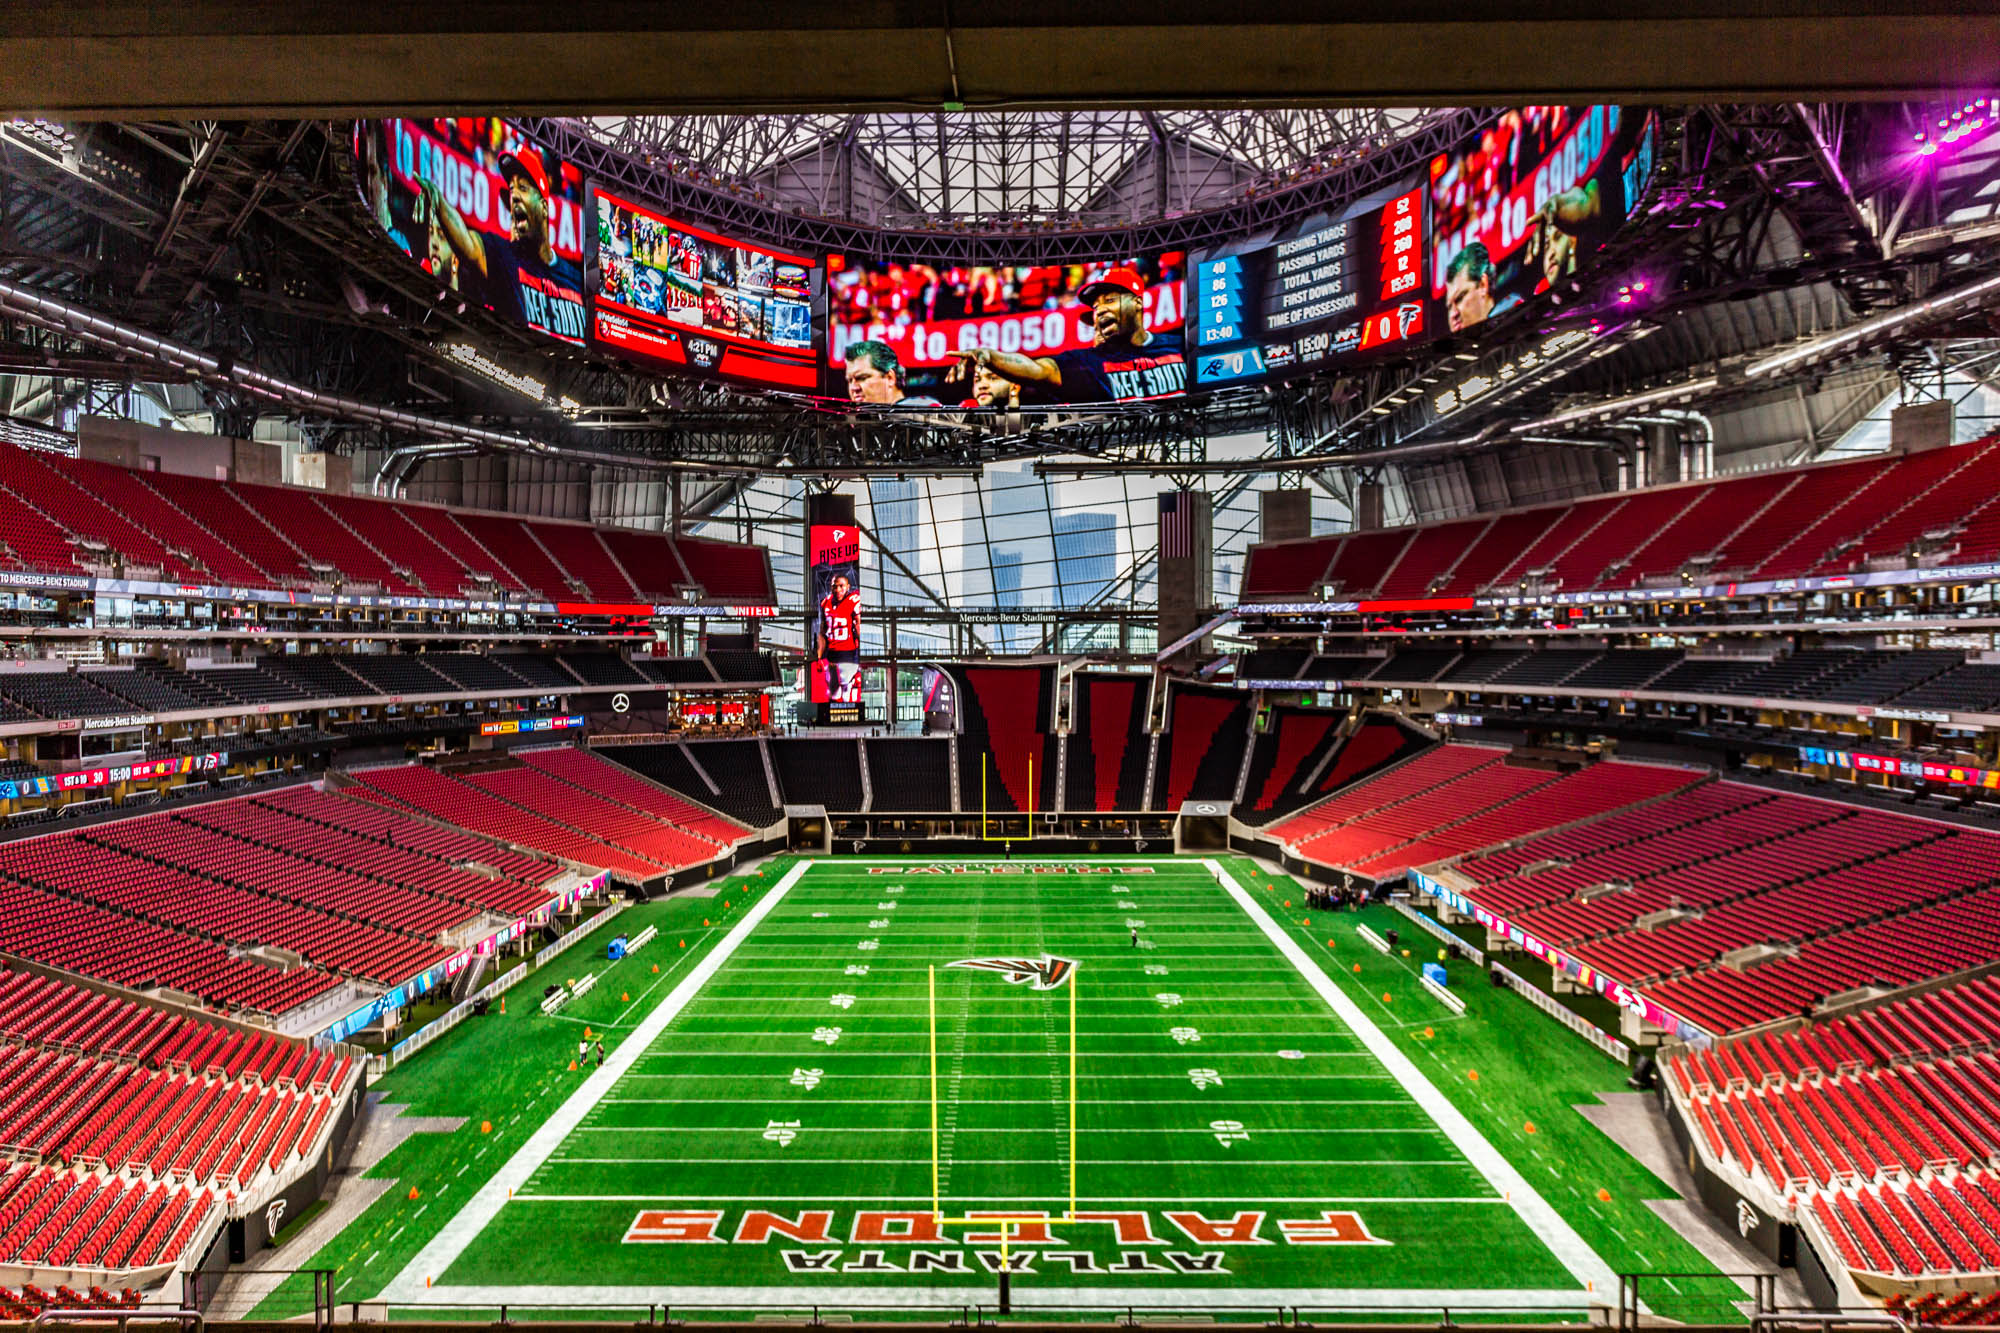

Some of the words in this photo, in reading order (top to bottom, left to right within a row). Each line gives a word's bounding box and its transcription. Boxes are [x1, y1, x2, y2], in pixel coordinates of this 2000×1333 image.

[1397, 197, 1409, 214] 52
[1278, 235, 1317, 257] RUSHING
[1317, 223, 1347, 244] YARDS
[1212, 261, 1226, 274] 40
[1278, 253, 1316, 275] PASSING
[1316, 242, 1346, 262] YARDS
[1212, 278, 1226, 291] 86
[1284, 272, 1311, 290] TOTAL
[1311, 262, 1341, 282] YARDS
[1210, 294, 1228, 308] 126
[1283, 290, 1308, 308] FIRST
[1308, 280, 1342, 300] DOWNS
[521, 283, 551, 330] NFC
[1215, 311, 1223, 323] 6
[1267, 313, 1290, 329] TIME
[1290, 308, 1303, 324] OF
[1303, 292, 1357, 320] POSSESSION
[912, 324, 947, 361] to
[957, 311, 1065, 353] 69050
[1206, 326, 1233, 341] 13:40
[1380, 317, 1390, 339] 0
[688, 340, 705, 353] 4:21
[705, 344, 718, 357] PM
[1298, 333, 1329, 354] 15:00
[1232, 354, 1243, 374] 0
[1107, 370, 1144, 399] NFC
[819, 546, 843, 564] RISE
[845, 543, 859, 557] UP
[10, 574, 63, 587] MERCEDES-BENZ
[63, 578, 89, 589] STADIUM
[960, 613, 1020, 623] Mercedes-Benz
[1021, 613, 1056, 623] Stadium
[84, 716, 130, 730] Mercedes-Benz
[130, 714, 155, 726] Stadium
[23, 781, 29, 795] 0
[94, 772, 103, 783] 30
[110, 767, 130, 782] 15:00
[790, 1067, 824, 1085] 20
[1188, 1068, 1223, 1087] 20
[762, 1119, 801, 1141] 10
[1209, 1120, 1250, 1142] 10
[621, 1209, 1395, 1246] FALCONS
[780, 1249, 1233, 1274] ATLANTA
